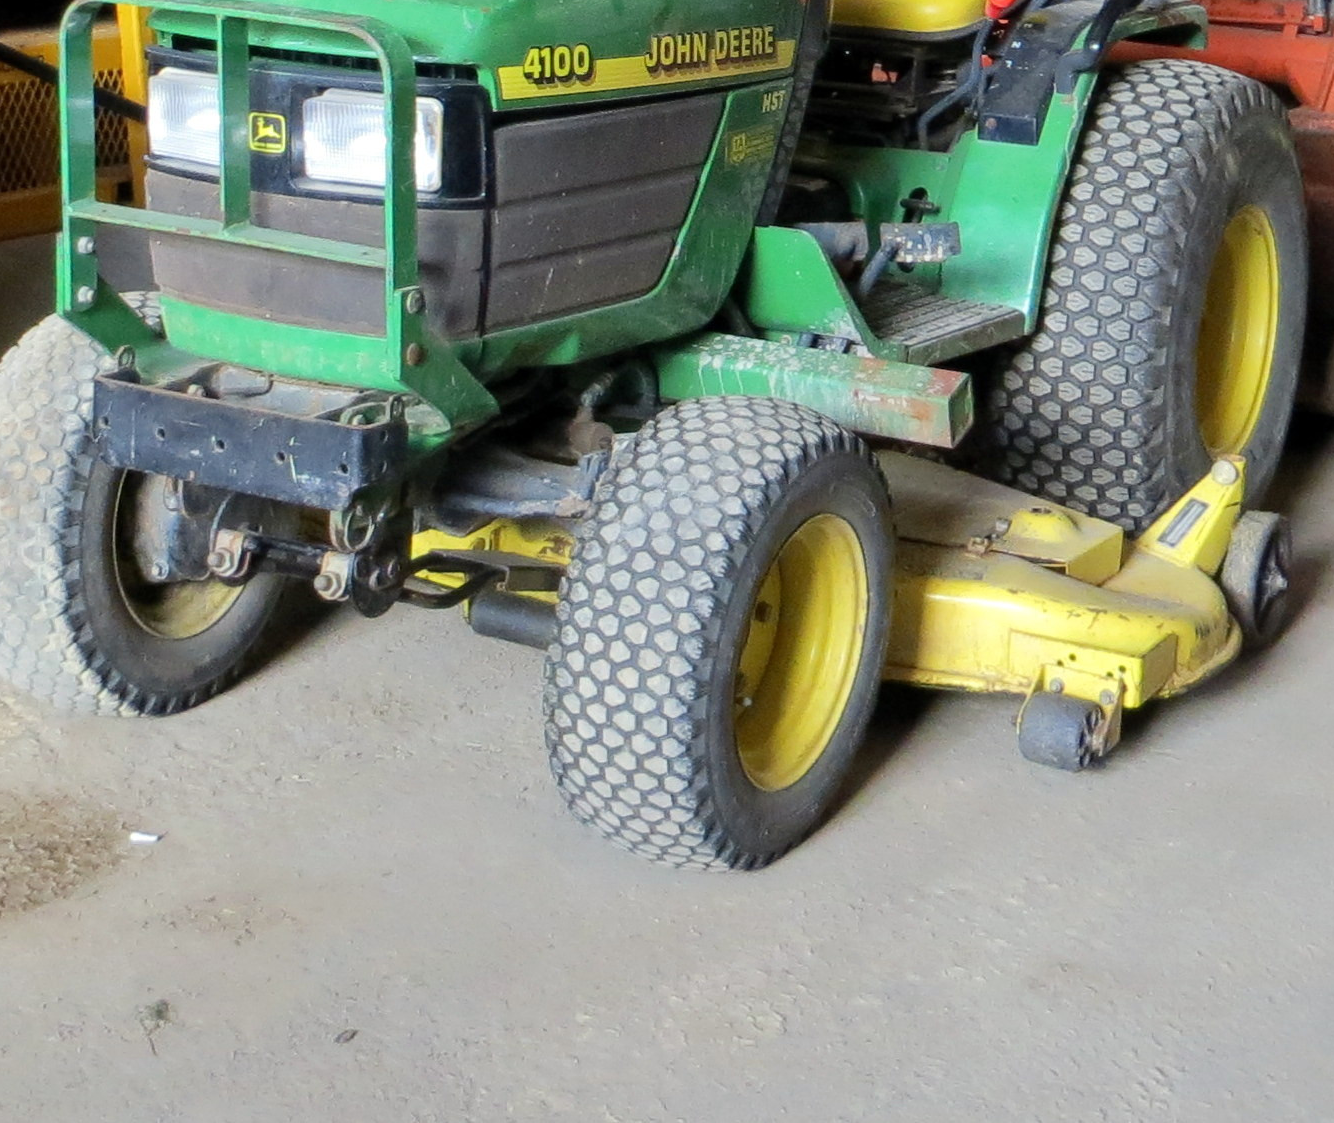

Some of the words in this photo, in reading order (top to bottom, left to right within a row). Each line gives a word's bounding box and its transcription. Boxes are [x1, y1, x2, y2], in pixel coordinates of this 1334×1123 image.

[523, 43, 593, 80] 4100
[643, 32, 709, 69] JOHN
[713, 25, 776, 60] DEERE
[762, 90, 786, 114] HST
